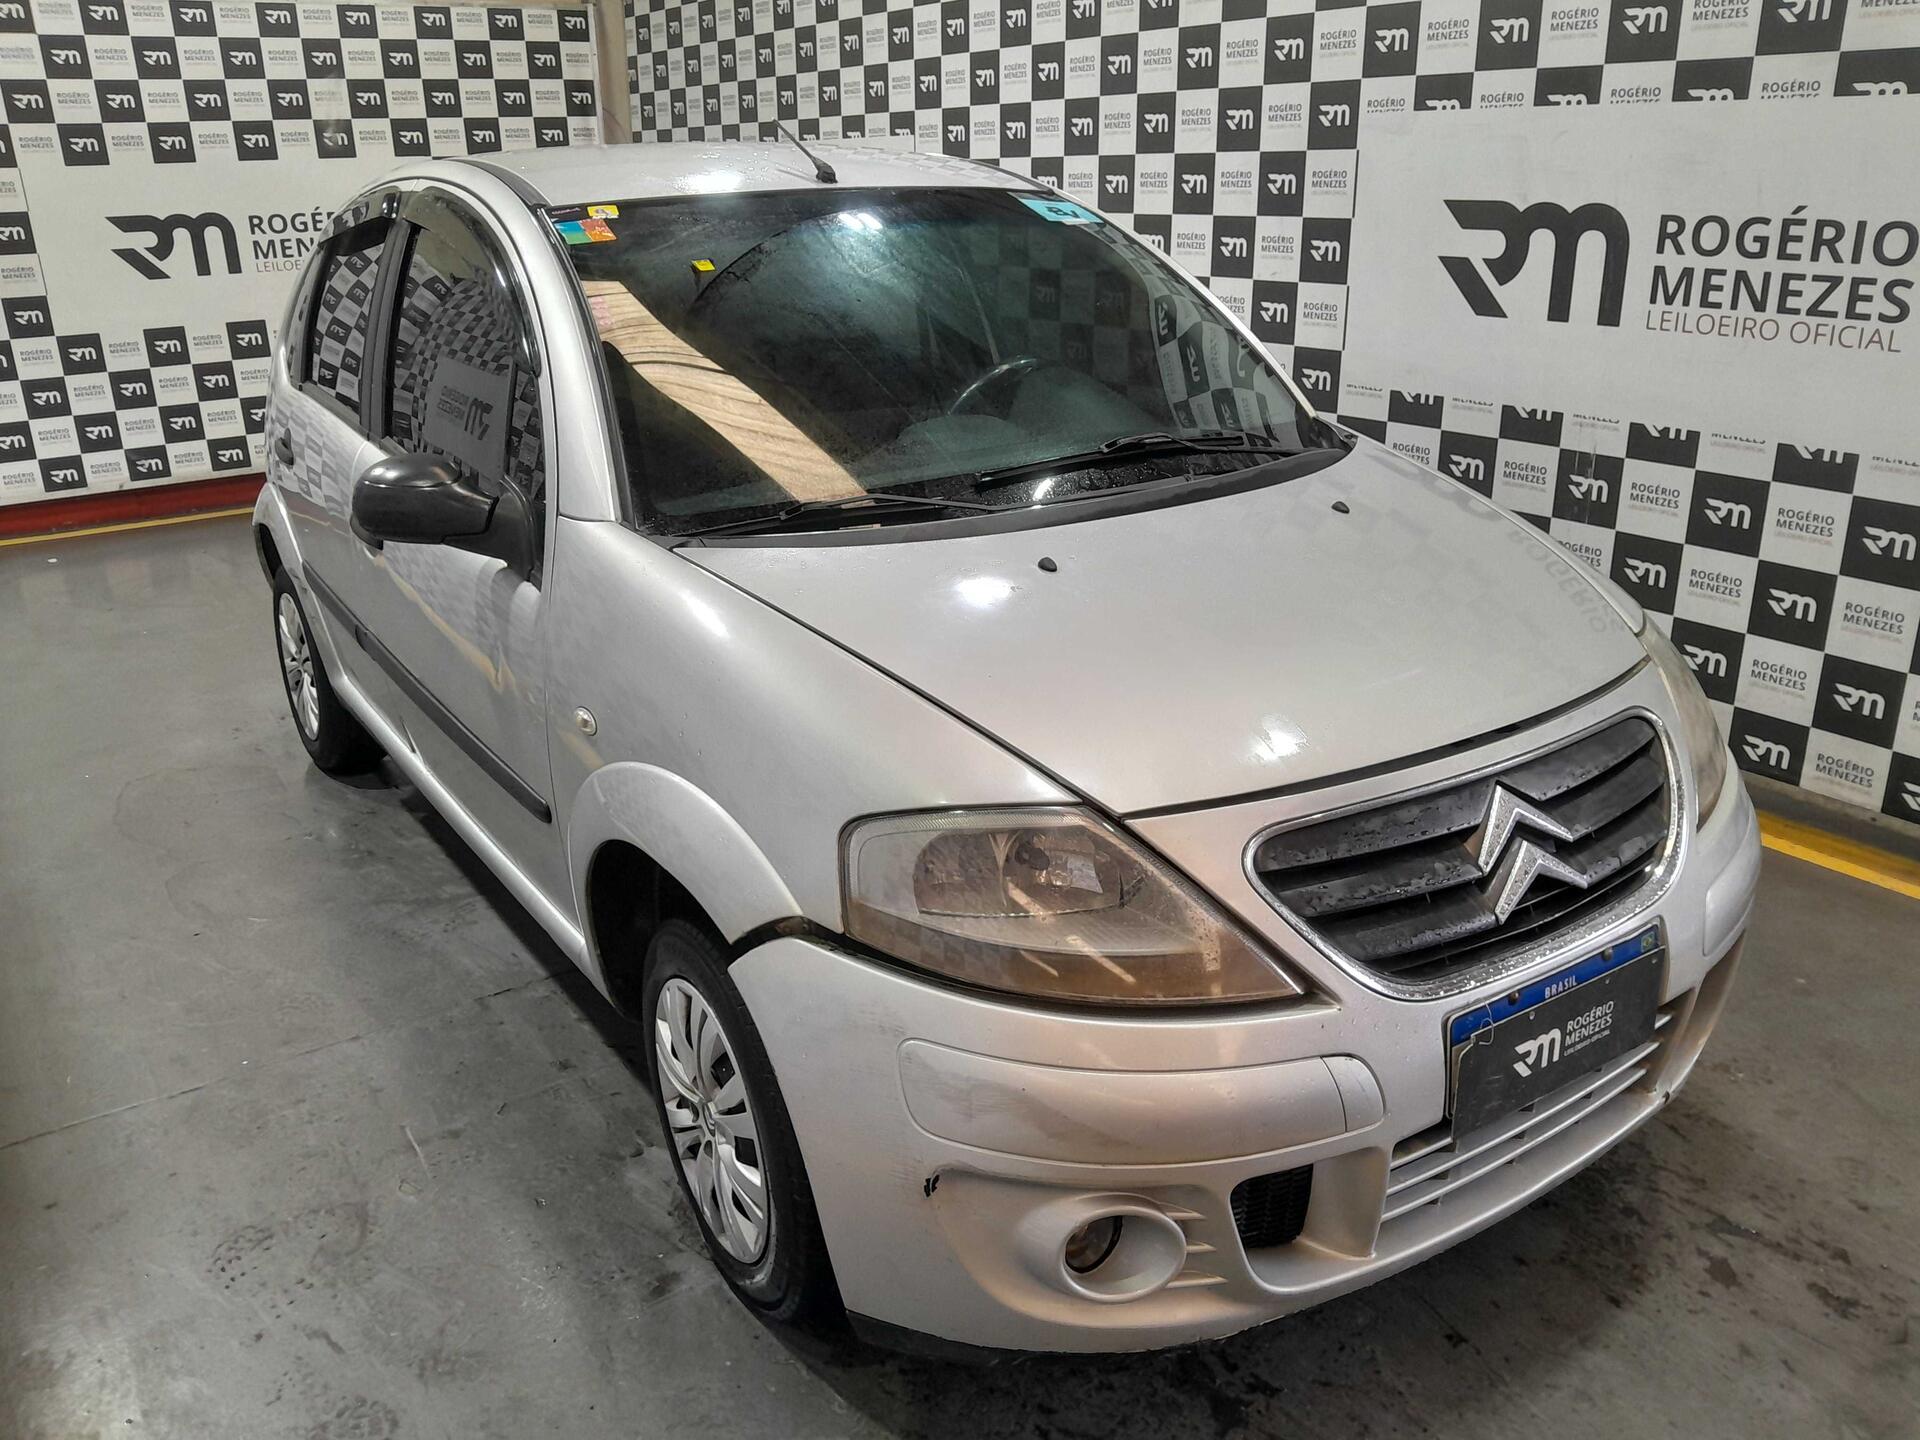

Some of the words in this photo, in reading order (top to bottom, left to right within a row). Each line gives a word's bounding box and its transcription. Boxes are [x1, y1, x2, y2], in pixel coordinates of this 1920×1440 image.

[1551, 7, 1599, 20] ROGÉRIO
[1692, 7, 1749, 21] MENEZES
[1428, 18, 1469, 31] ROGÉRIO
[1550, 18, 1598, 31] MENEZES
[1320, 29, 1356, 41] ROGÉRIO
[1427, 30, 1469, 41] MENEZES
[1226, 39, 1258, 50] ROGÉRIO
[1320, 39, 1357, 50] MENEZES
[1144, 48, 1172, 58] ROGÉRIO
[1226, 48, 1258, 58] MENEZES
[1070, 56, 1095, 64] ROGÉRIO
[1144, 56, 1172, 66] MENEZES
[1070, 63, 1095, 72] MENEZES
[1611, 86, 1661, 98] ROGÉRIO
[1762, 80, 1820, 93] ROGÉRIO
[1368, 96, 1405, 108] ROGÉRIO
[1481, 92, 1524, 103] ROGÉRIO
[1182, 108, 1211, 118] ROGÉRIO
[1268, 103, 1302, 114] ROGÉRIO
[1104, 112, 1131, 122] ROGÉRIO
[1182, 116, 1211, 126] MENEZES
[1268, 112, 1302, 122] MENEZES
[1104, 120, 1131, 129] MENEZES
[1140, 171, 1168, 180] ROGÉRIO
[1221, 170, 1252, 180] ROGÉRIO
[1313, 170, 1347, 180] ROGÉRIO
[1140, 179, 1168, 188] MENEZES
[1220, 179, 1251, 188] MENEZES
[1312, 179, 1347, 188] MENEZES
[248, 206, 335, 235] ROGÉ
[1177, 233, 1206, 241] ROGÉRIO
[1262, 234, 1294, 245] ROGÉRIO
[1656, 205, 1919, 267] ROGÉRIO
[1177, 240, 1206, 249] MENEZES
[1261, 243, 1293, 254] MENEZES
[1649, 265, 1915, 324] MENEZES
[1304, 302, 1337, 313] ROGÉRIO
[1304, 310, 1337, 321] MENEZES
[1645, 309, 1780, 341] LEILOEIRO
[1789, 321, 1902, 353] OFICIAL
[1393, 442, 1430, 455] ROGÉRIO
[1504, 461, 1547, 475] ROGÉRIO
[1503, 470, 1546, 485] MENEZES
[1631, 482, 1680, 498] ROGÉRIO
[1630, 492, 1679, 509] MENEZES
[1778, 508, 1834, 526] ROGÉRIO
[1776, 518, 1833, 538] MENEZES
[1690, 569, 1742, 588] ROGÉRIO
[1689, 579, 1741, 598] MENEZES
[1845, 602, 1904, 622] ROGÉRIO
[1843, 612, 1903, 635] MENEZES
[1752, 659, 1807, 680] ROGÉRIO
[1751, 669, 1806, 691] MENEZES
[1817, 753, 1874, 777] ROGÉRIO
[1815, 764, 1872, 788] MENEZES
[1545, 975, 1578, 999] BRASIL
[1567, 1001, 1614, 1033] ROGÉRIO
[1565, 1014, 1612, 1046] MENEZES
